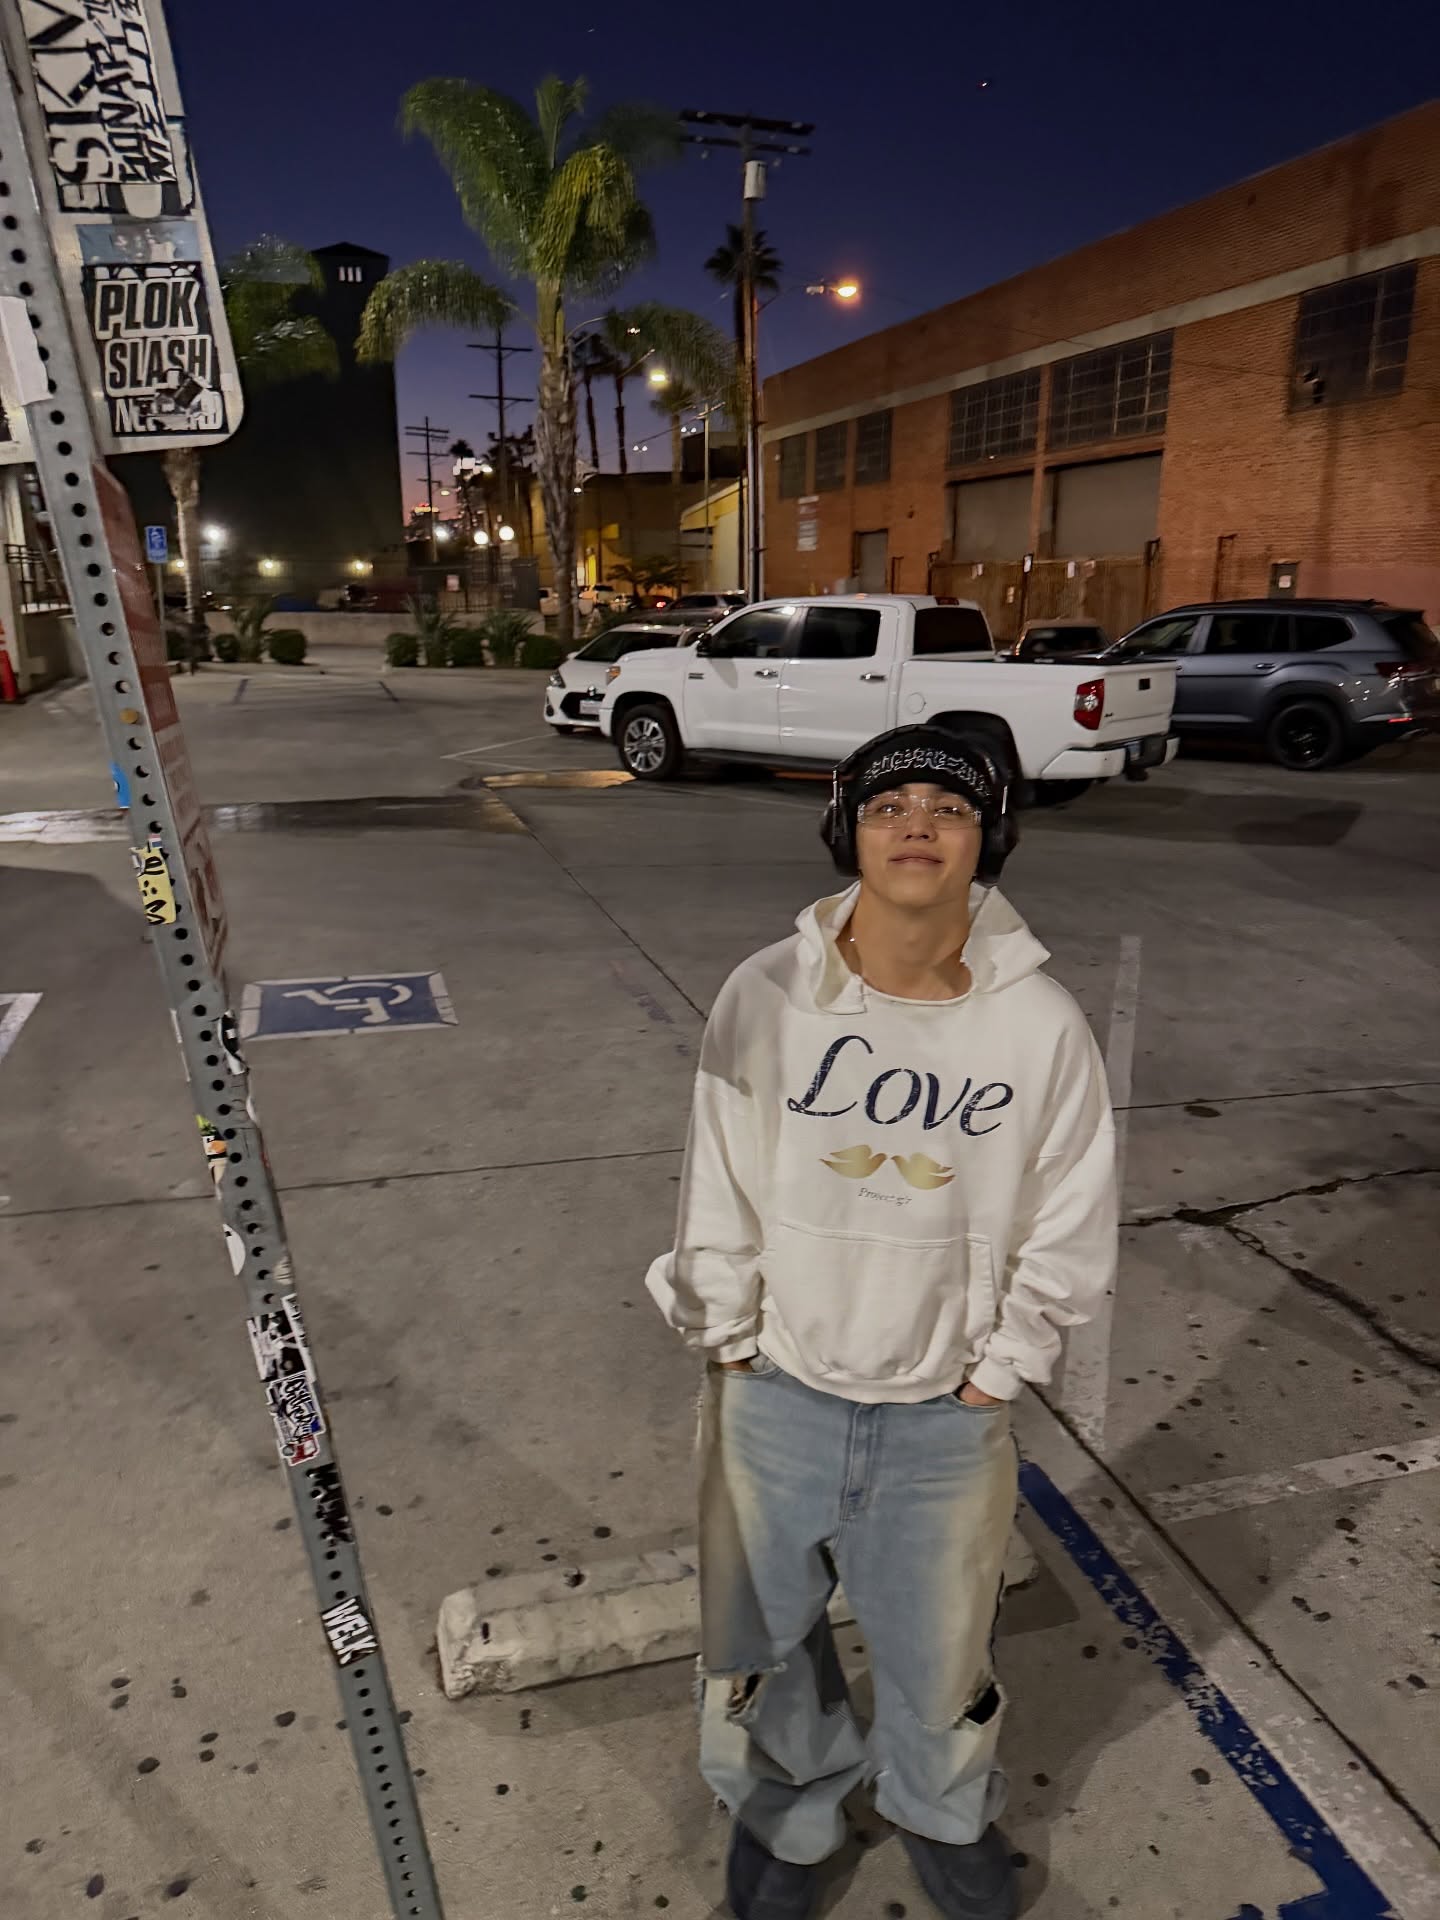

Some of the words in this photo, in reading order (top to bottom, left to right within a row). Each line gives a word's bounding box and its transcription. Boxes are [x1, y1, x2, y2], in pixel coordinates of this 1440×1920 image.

[97, 279, 198, 335] PLOK
[107, 335, 211, 393] SLASH
[787, 1035, 1013, 1136] Love
